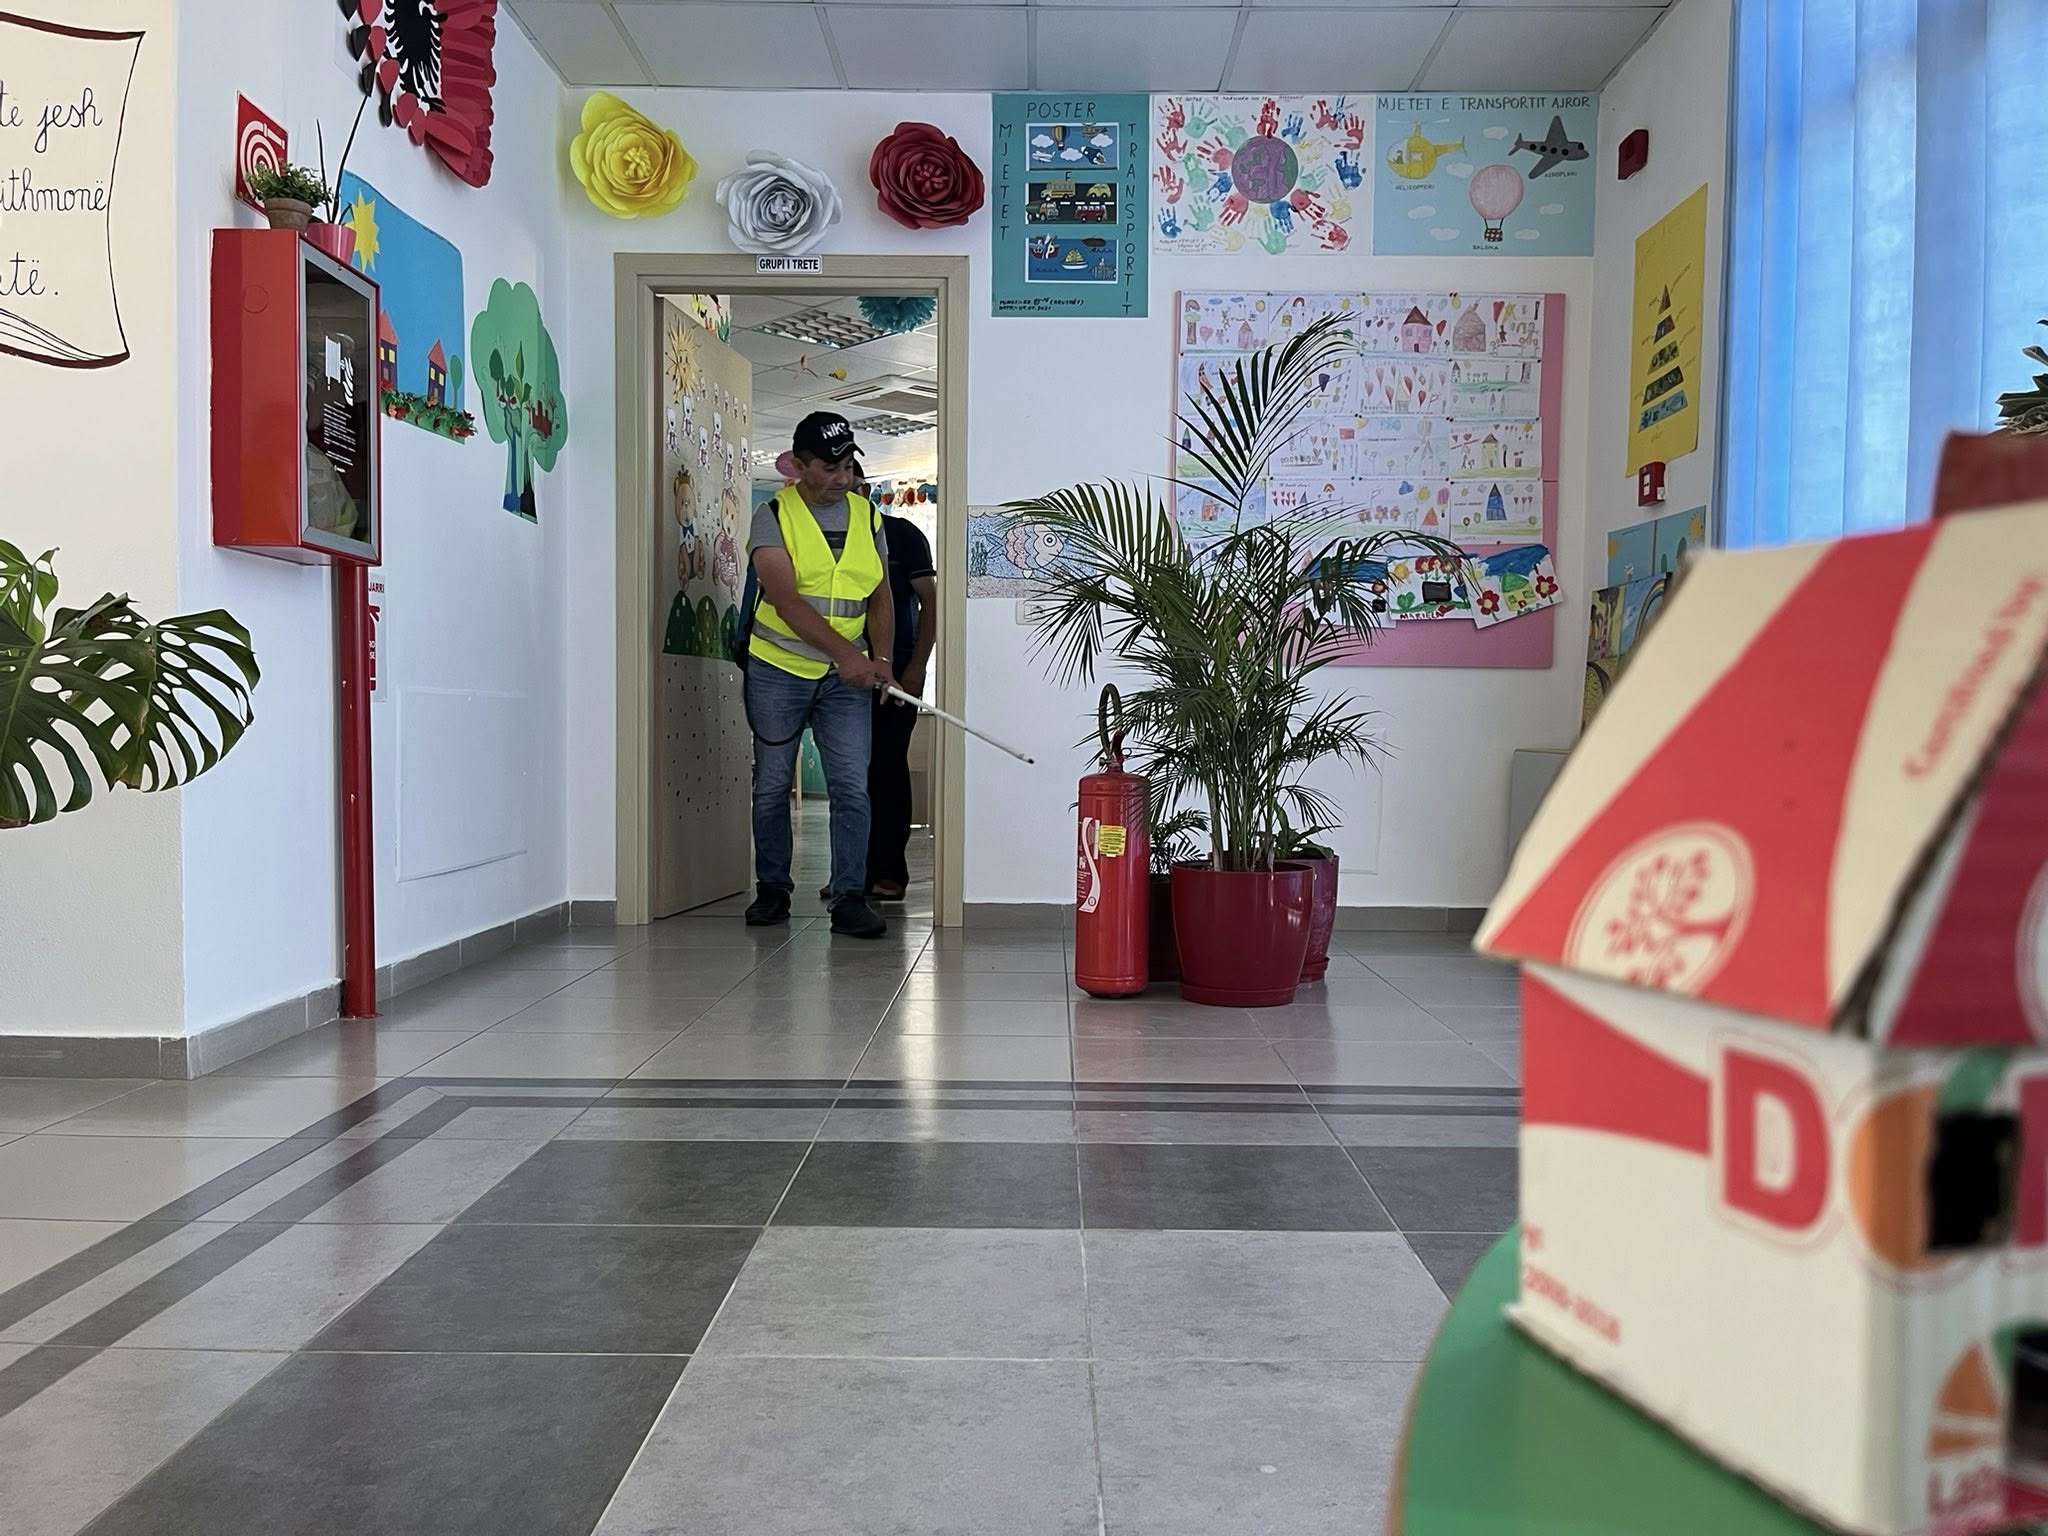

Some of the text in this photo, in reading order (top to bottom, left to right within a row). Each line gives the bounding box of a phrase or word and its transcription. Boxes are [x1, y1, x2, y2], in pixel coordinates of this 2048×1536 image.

[35, 87, 103, 153] jesh
[1027, 102, 1096, 118] POSTER
[1378, 96, 1591, 111] MJETET E TRANSPORTIT AJROR
[0, 167, 107, 212] ithmonë
[999, 124, 1012, 240] MJETET
[1121, 123, 1138, 315] TRANSPORTIT
[760, 258, 819, 270] GRUPI I TRETE
